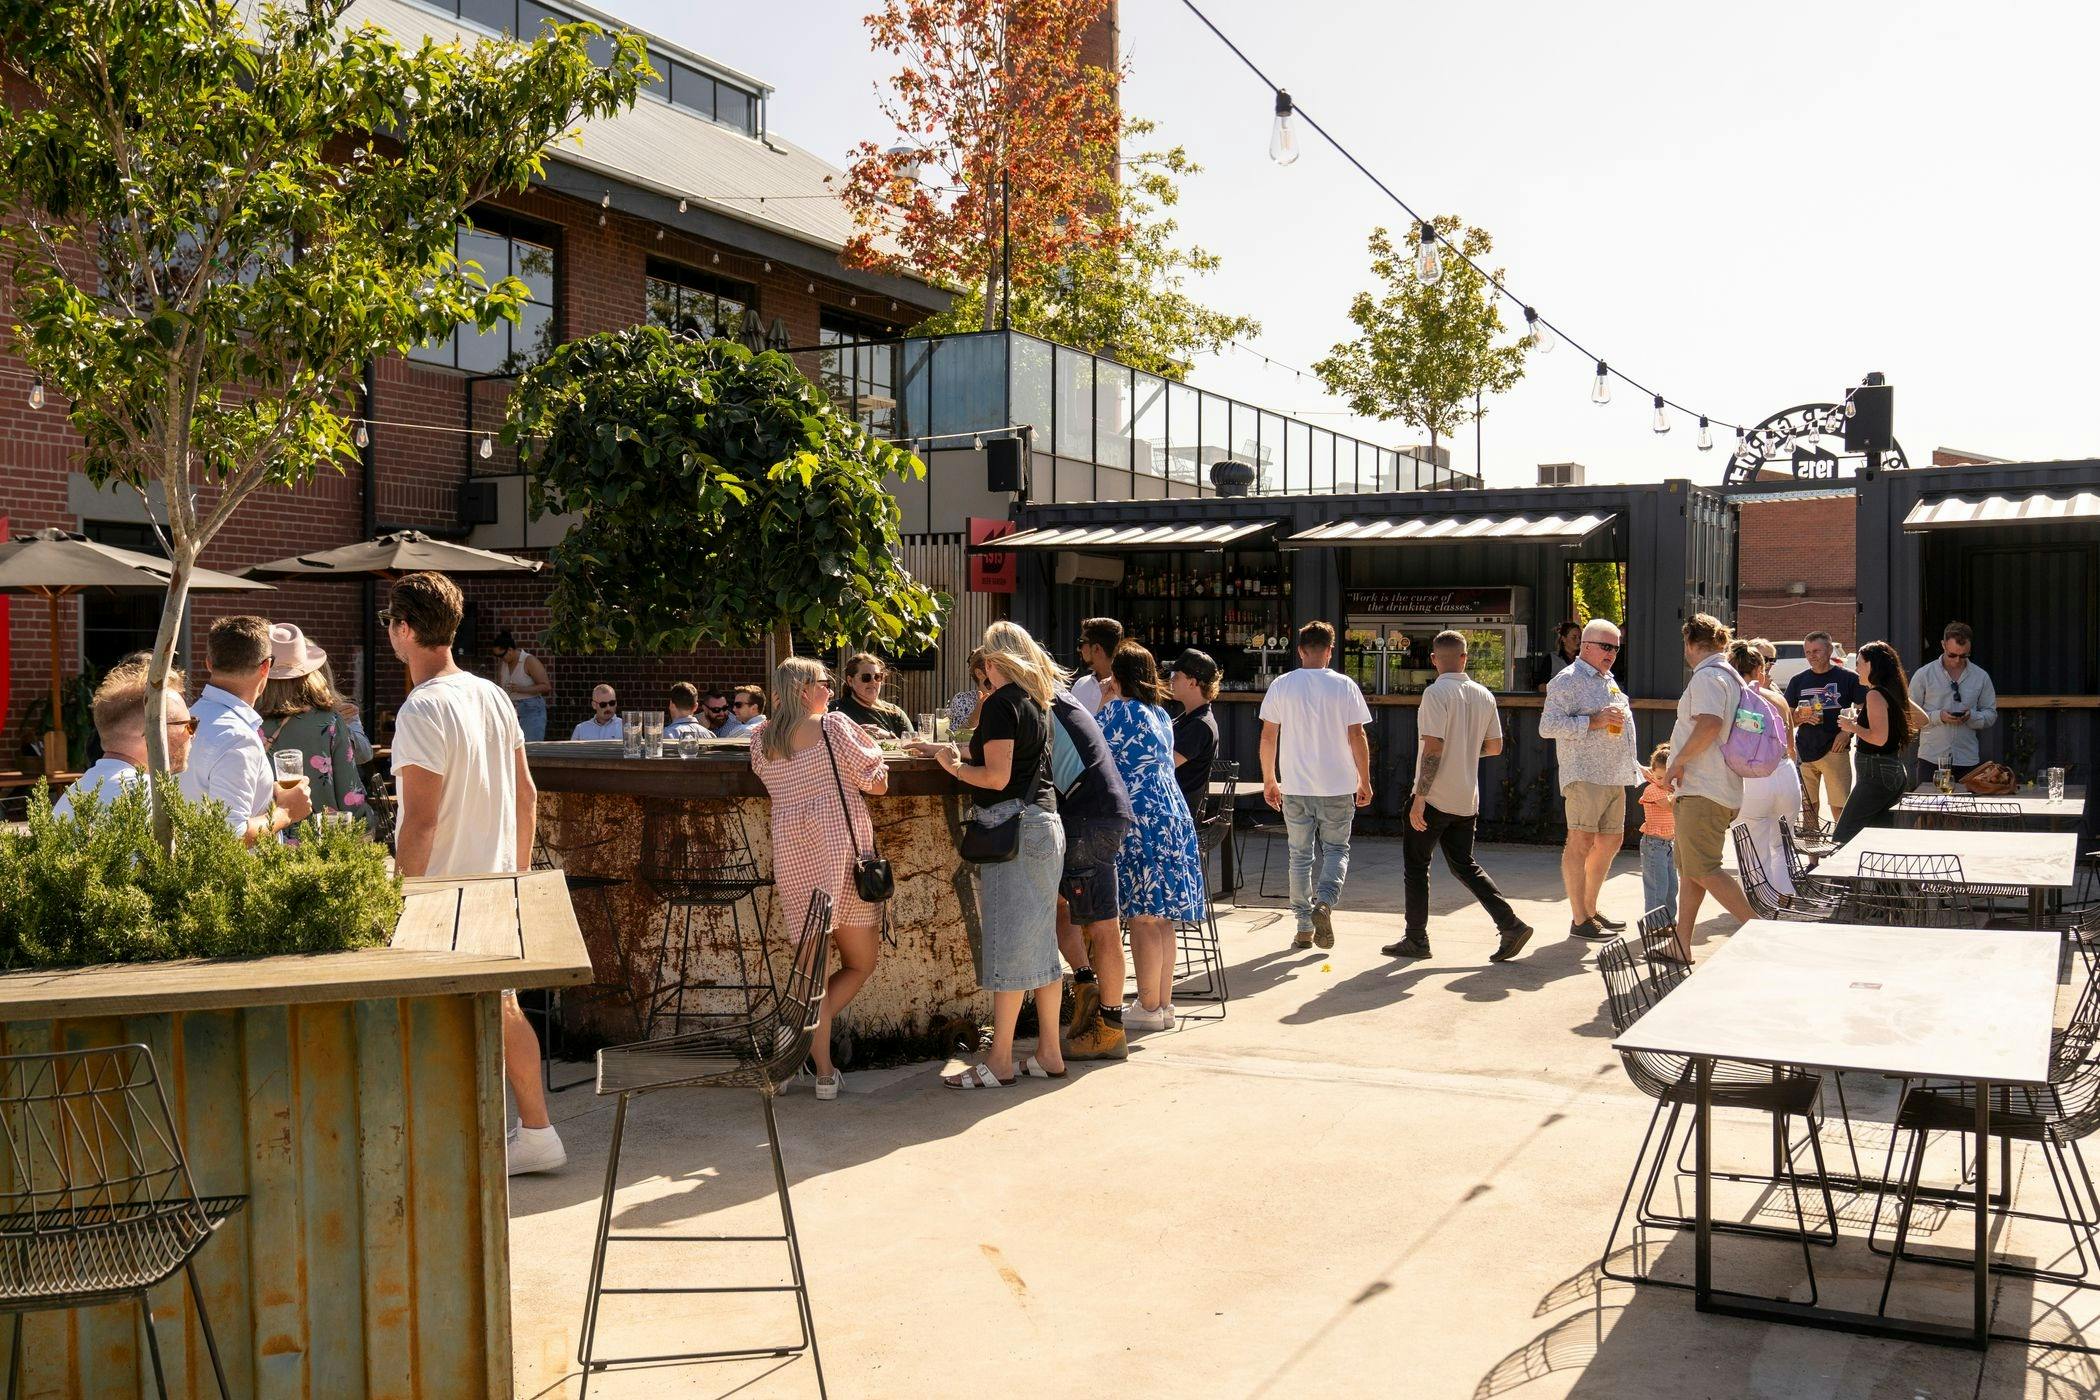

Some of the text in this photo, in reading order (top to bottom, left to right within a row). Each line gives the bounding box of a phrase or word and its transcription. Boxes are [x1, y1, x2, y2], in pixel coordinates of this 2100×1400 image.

[1381, 592, 1389, 602] is
[1392, 592, 1408, 602] the
[1411, 594, 1438, 602] curse
[1441, 592, 1454, 604] of
[1368, 602, 1384, 611] the
[1387, 602, 1431, 613] drinking
